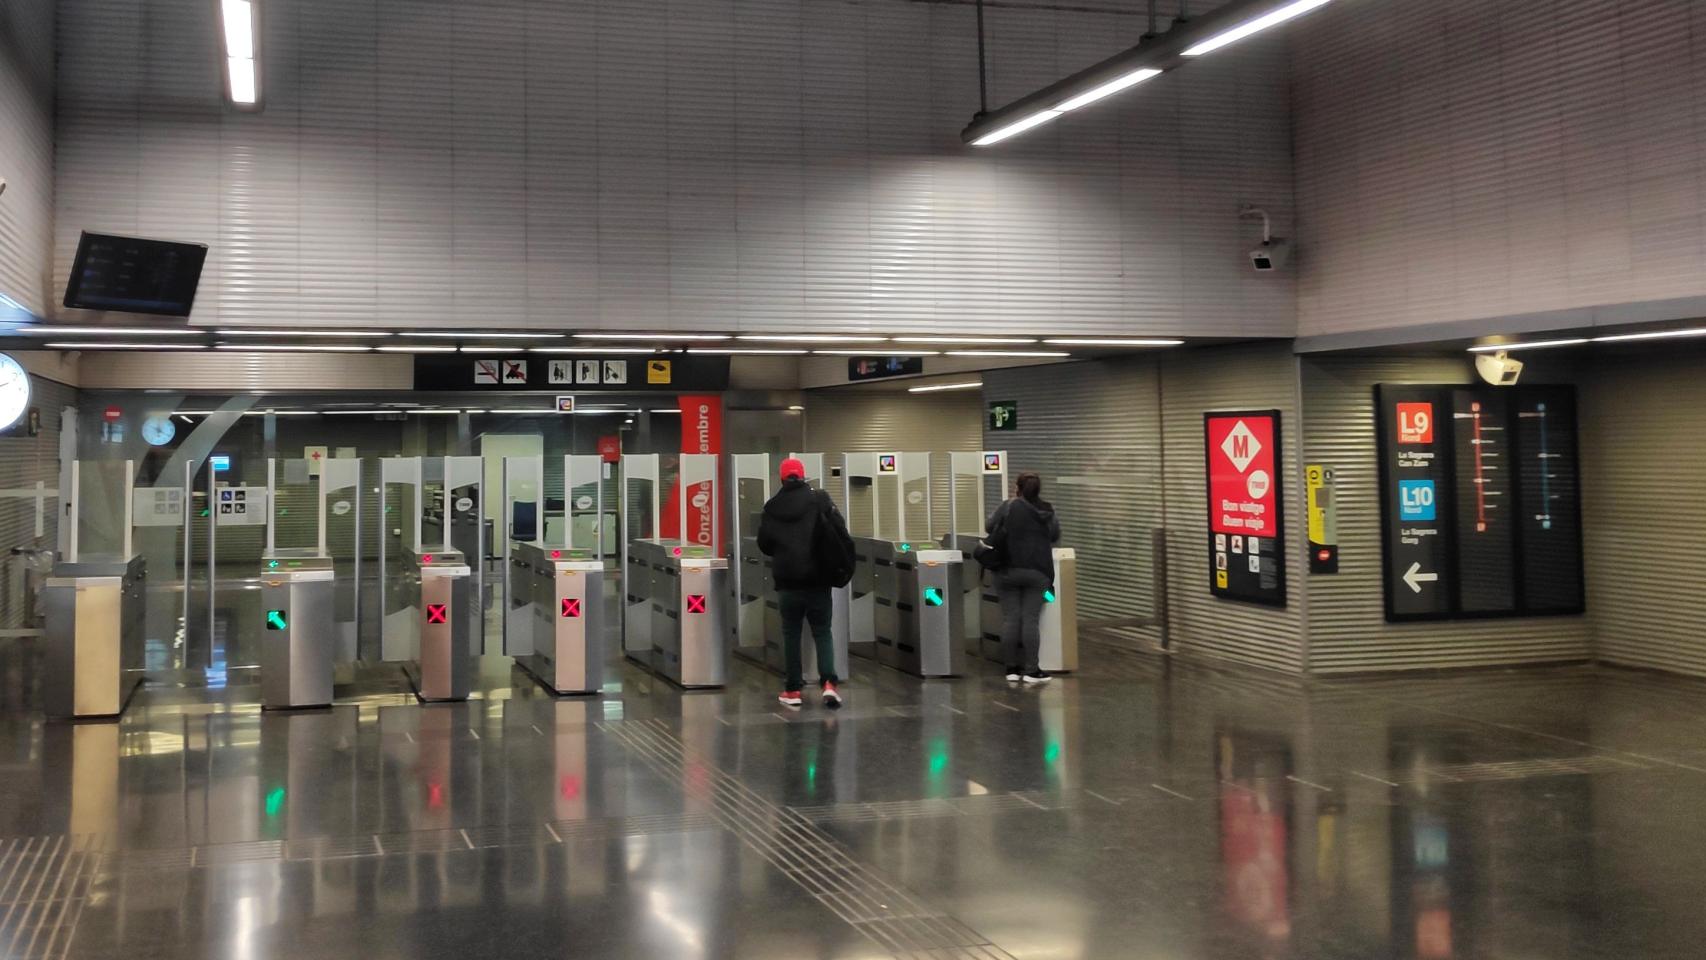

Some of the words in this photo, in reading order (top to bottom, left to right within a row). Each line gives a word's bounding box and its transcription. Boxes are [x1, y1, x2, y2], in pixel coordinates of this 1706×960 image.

[1401, 411, 1429, 434] L9
[1233, 434, 1249, 458] M
[1402, 487, 1433, 506] L10
[698, 506, 711, 544] Onze
